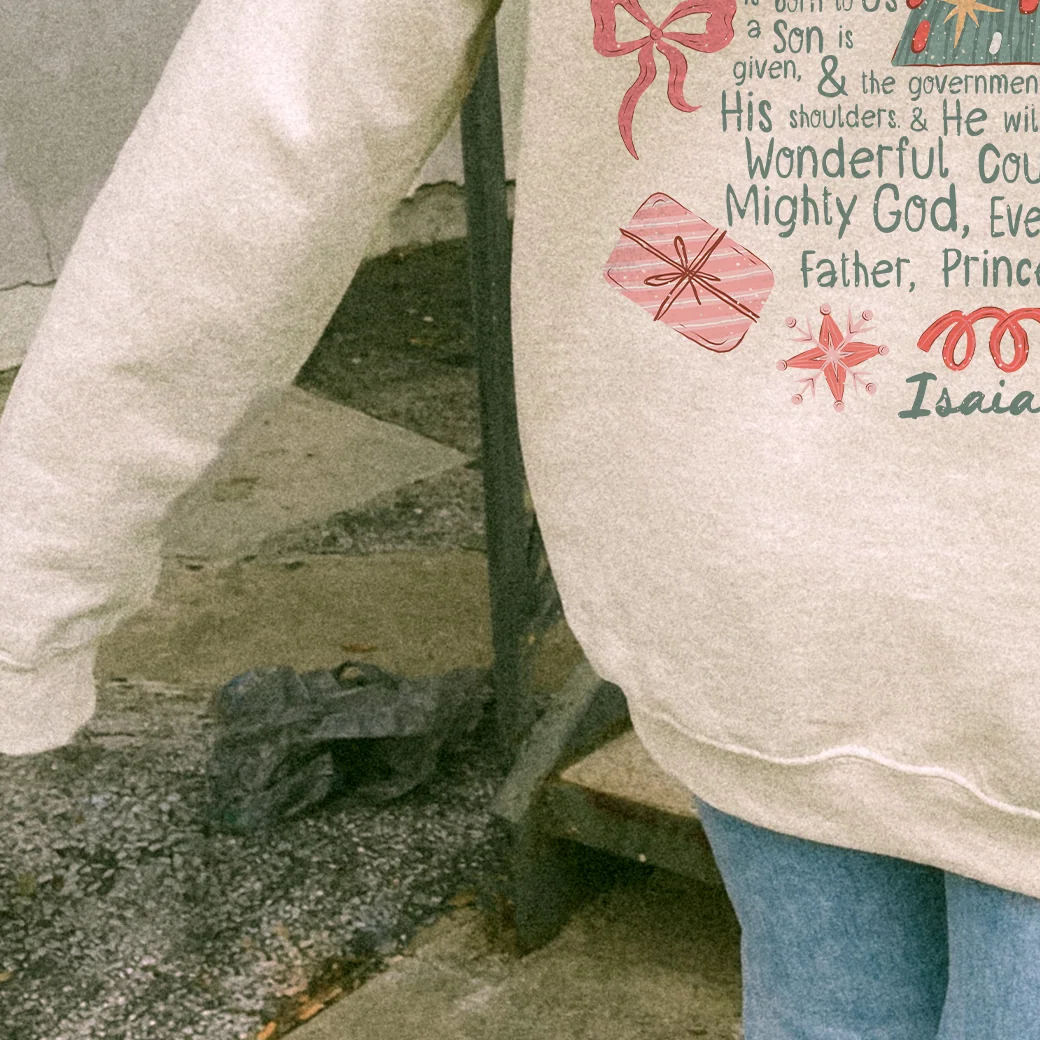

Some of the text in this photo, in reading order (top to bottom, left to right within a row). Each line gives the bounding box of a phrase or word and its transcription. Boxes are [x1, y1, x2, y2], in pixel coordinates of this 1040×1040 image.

[747, 19, 854, 53] a Son is
[733, 56, 802, 87] given,
[817, 54, 849, 98] &
[863, 73, 895, 94] the
[722, 91, 772, 132] His
[910, 106, 929, 132] &
[944, 100, 987, 136] He
[746, 136, 948, 179] Wonderful
[727, 184, 856, 238] Mighty
[874, 184, 969, 238] God,
[801, 251, 915, 291] Father,
